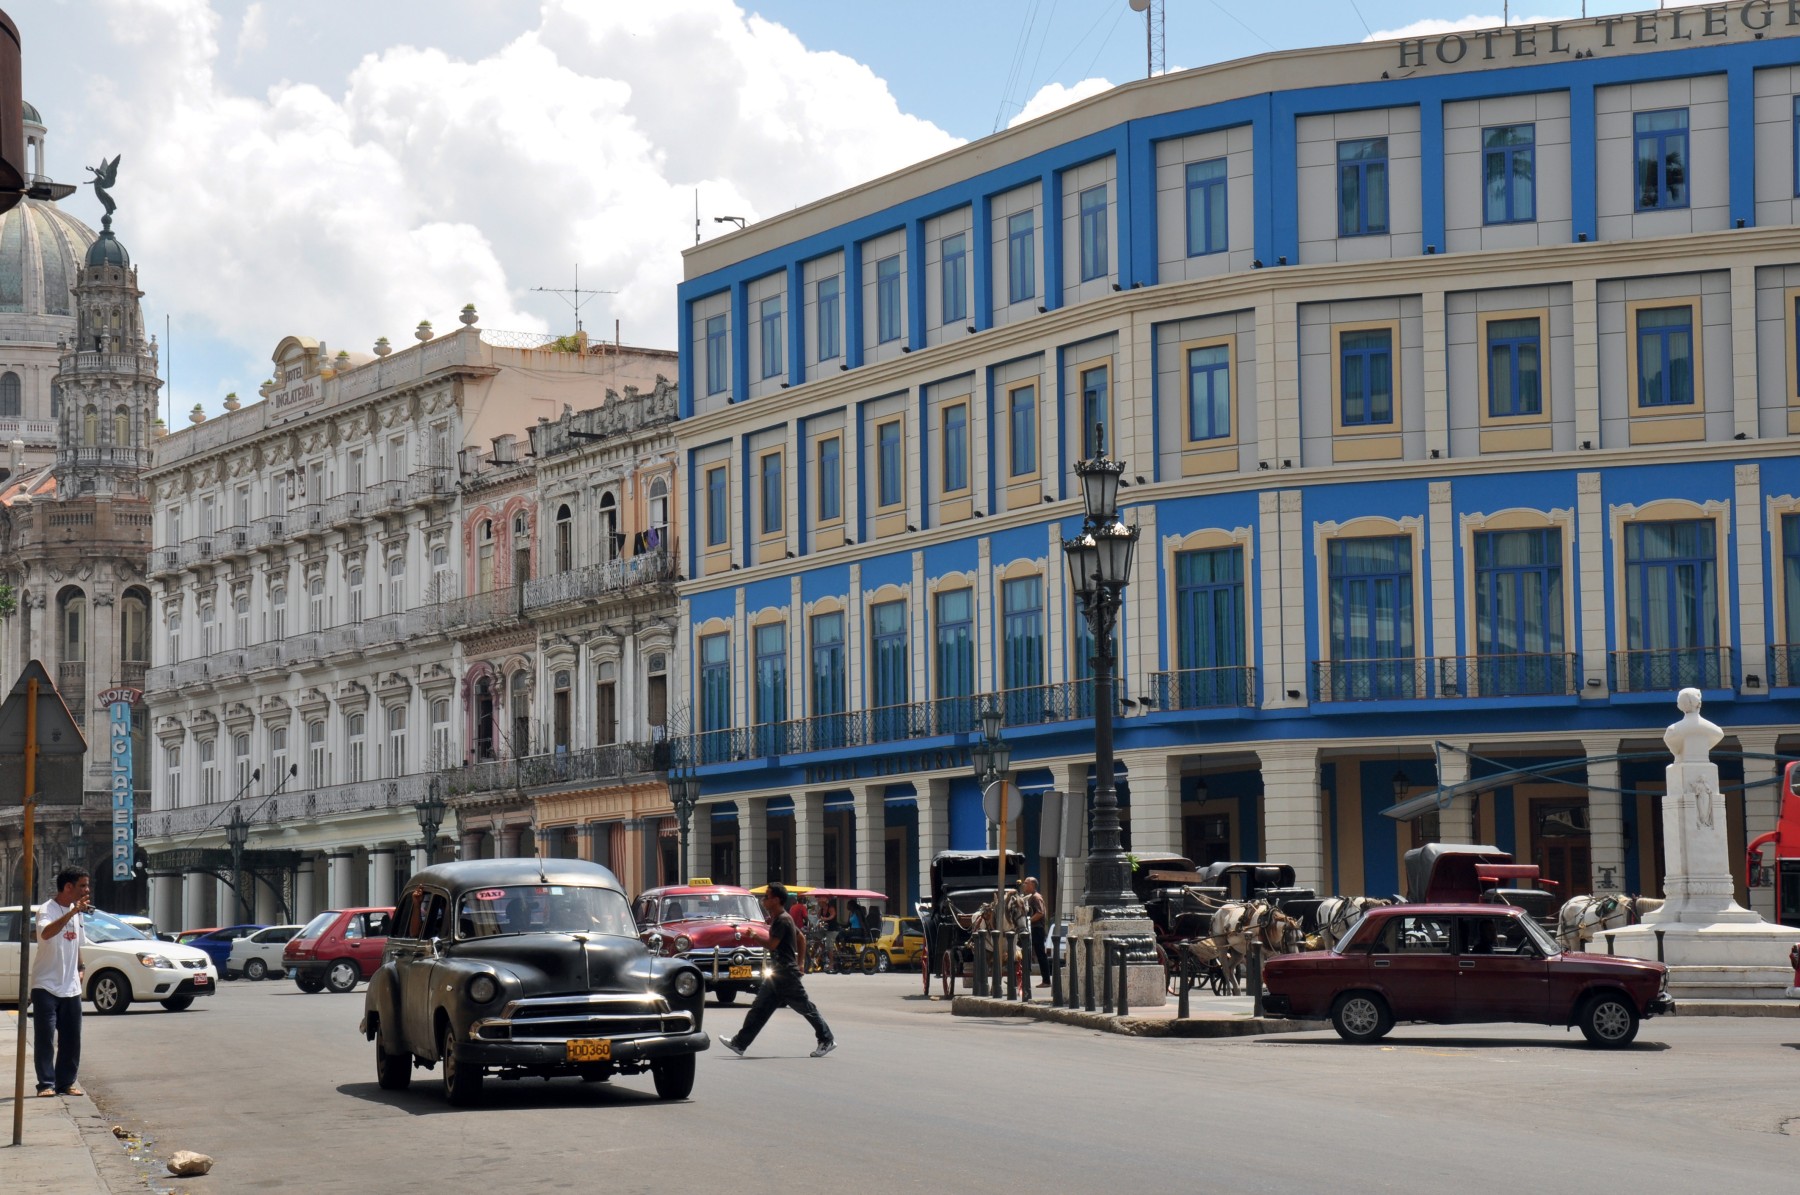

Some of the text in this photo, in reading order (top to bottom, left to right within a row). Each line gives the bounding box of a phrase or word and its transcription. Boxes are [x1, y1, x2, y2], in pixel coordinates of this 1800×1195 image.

[1398, 24, 1570, 68] HOTEL
[285, 367, 303, 382] HOTEL
[276, 383, 314, 408] INGLATERRA
[100, 690, 134, 704] HOTEL
[804, 762, 859, 784] HOTEL
[112, 704, 128, 877] INGLATERRA
